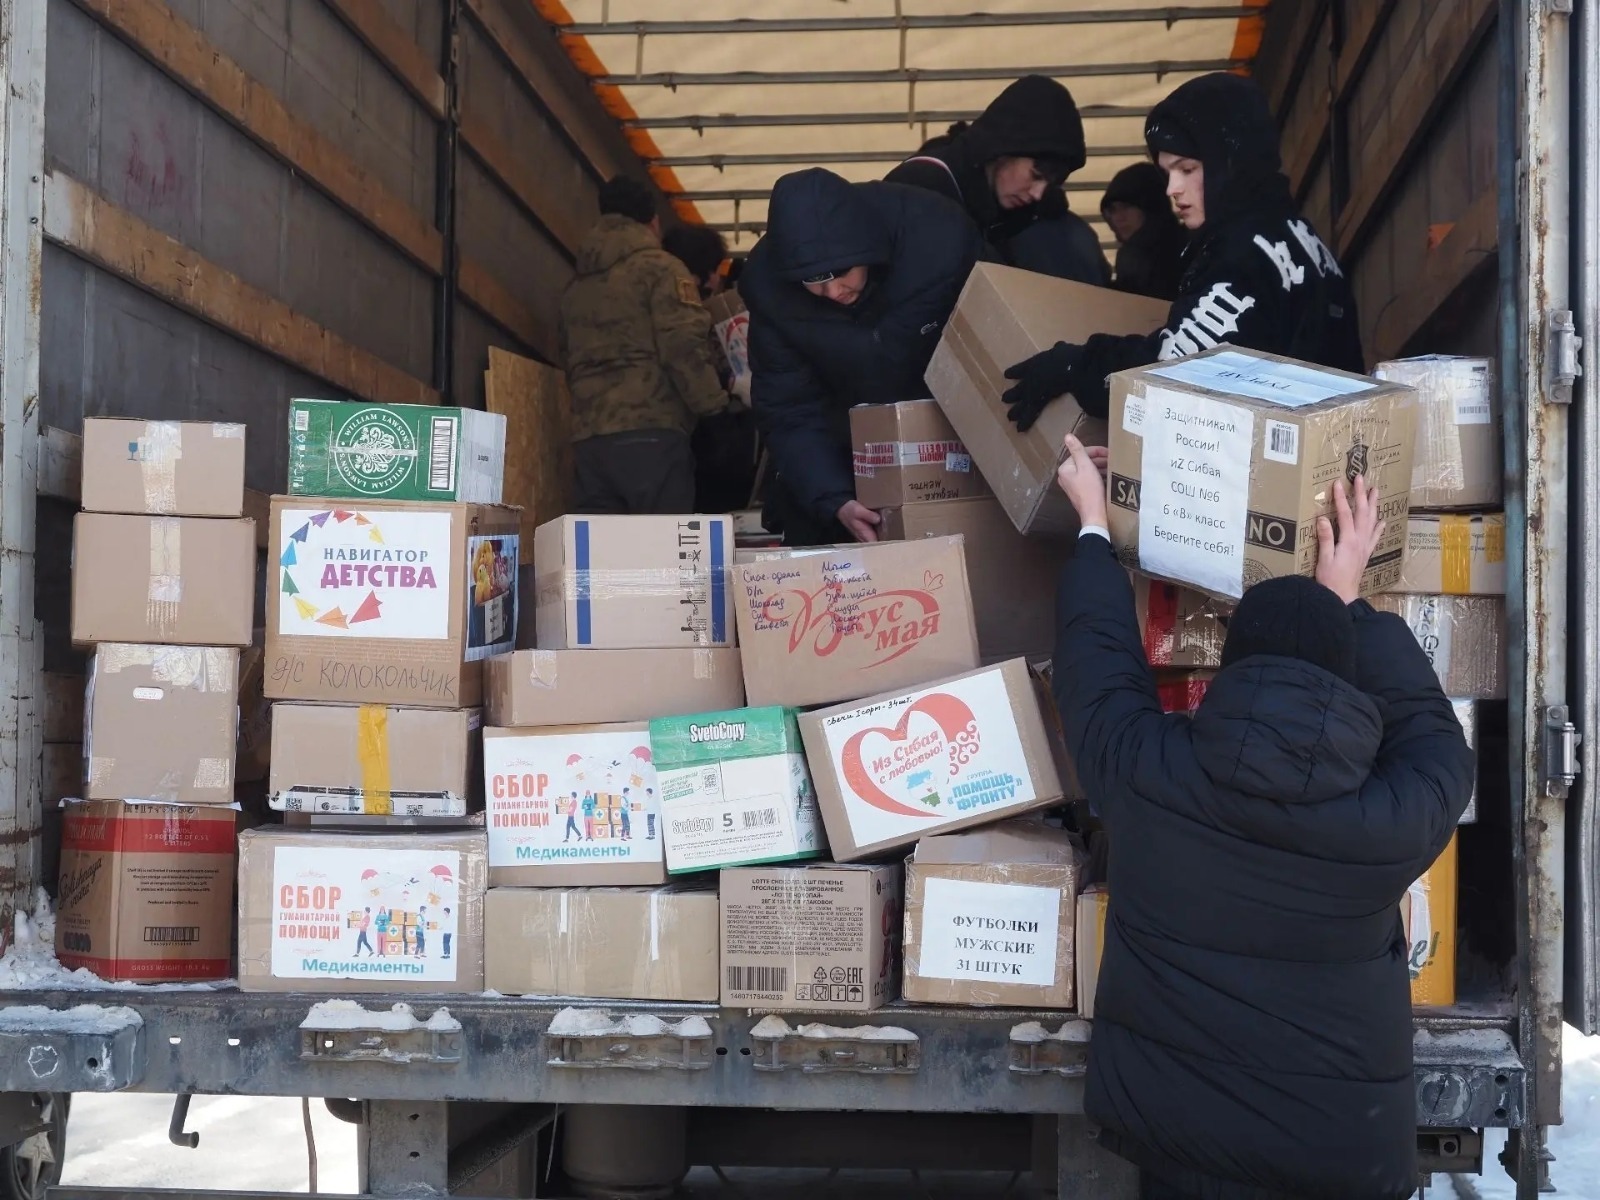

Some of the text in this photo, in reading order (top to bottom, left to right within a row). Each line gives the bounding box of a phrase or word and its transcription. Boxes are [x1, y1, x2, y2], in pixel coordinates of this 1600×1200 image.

[344, 413, 378, 437] WILLIAM
[1164, 407, 1236, 434] Защитникам
[1175, 432, 1221, 453] России!
[370, 466, 404, 490] WILLIAM
[1187, 461, 1222, 479] Сибая
[1170, 480, 1220, 503] СОШ №6
[1163, 504, 1226, 529] 6 «В» класс
[1154, 525, 1235, 557] Берегите себя!
[323, 547, 430, 563] НАВИГАТОР
[320, 564, 437, 588] ДЕТСТВА
[874, 611, 941, 652] мая
[689, 720, 745, 743] SvetoCopy
[871, 729, 939, 774] Из Сибая
[888, 741, 944, 782] любовью!
[966, 769, 993, 781] ГРУППА
[493, 774, 549, 798] СБОР
[493, 800, 549, 810] ГУМАНИТАРНОЙ
[493, 811, 550, 829] ПОМОЩИ
[672, 817, 714, 834] SvetoCopy
[722, 813, 733, 827] 5
[515, 845, 631, 860] Медикаменты
[280, 884, 342, 910] СБОР
[279, 912, 341, 922] ГУМАНИТАРНОЙ
[952, 915, 1039, 933] ФУТБОЛКИ
[279, 924, 341, 942] ПОМОЩИ
[955, 937, 1035, 954] МУЖСКИЕ
[302, 958, 425, 974] Медикаменты
[847, 967, 863, 983] EAC
[956, 959, 1022, 974] 31 ШТУК
